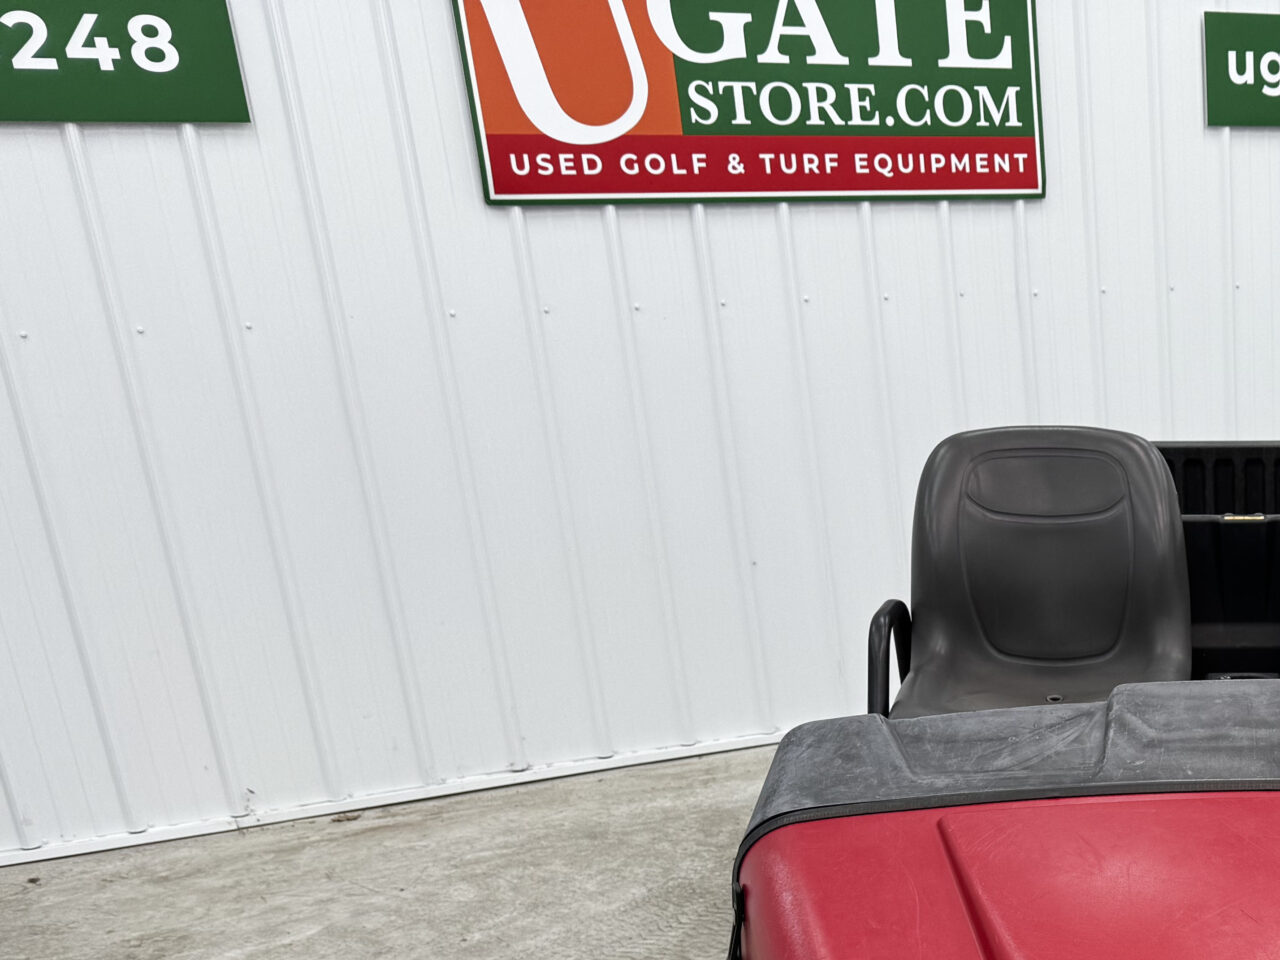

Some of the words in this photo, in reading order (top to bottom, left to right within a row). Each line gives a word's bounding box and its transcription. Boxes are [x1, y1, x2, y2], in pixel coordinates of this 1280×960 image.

[0, 11, 179, 72] 248
[688, 80, 1022, 126] STORE.COM
[510, 154, 602, 175] USED
[620, 154, 706, 174] GOLF
[728, 154, 744, 174] &
[759, 154, 838, 173] TURF
[855, 154, 1027, 177] EQUIPMENT
